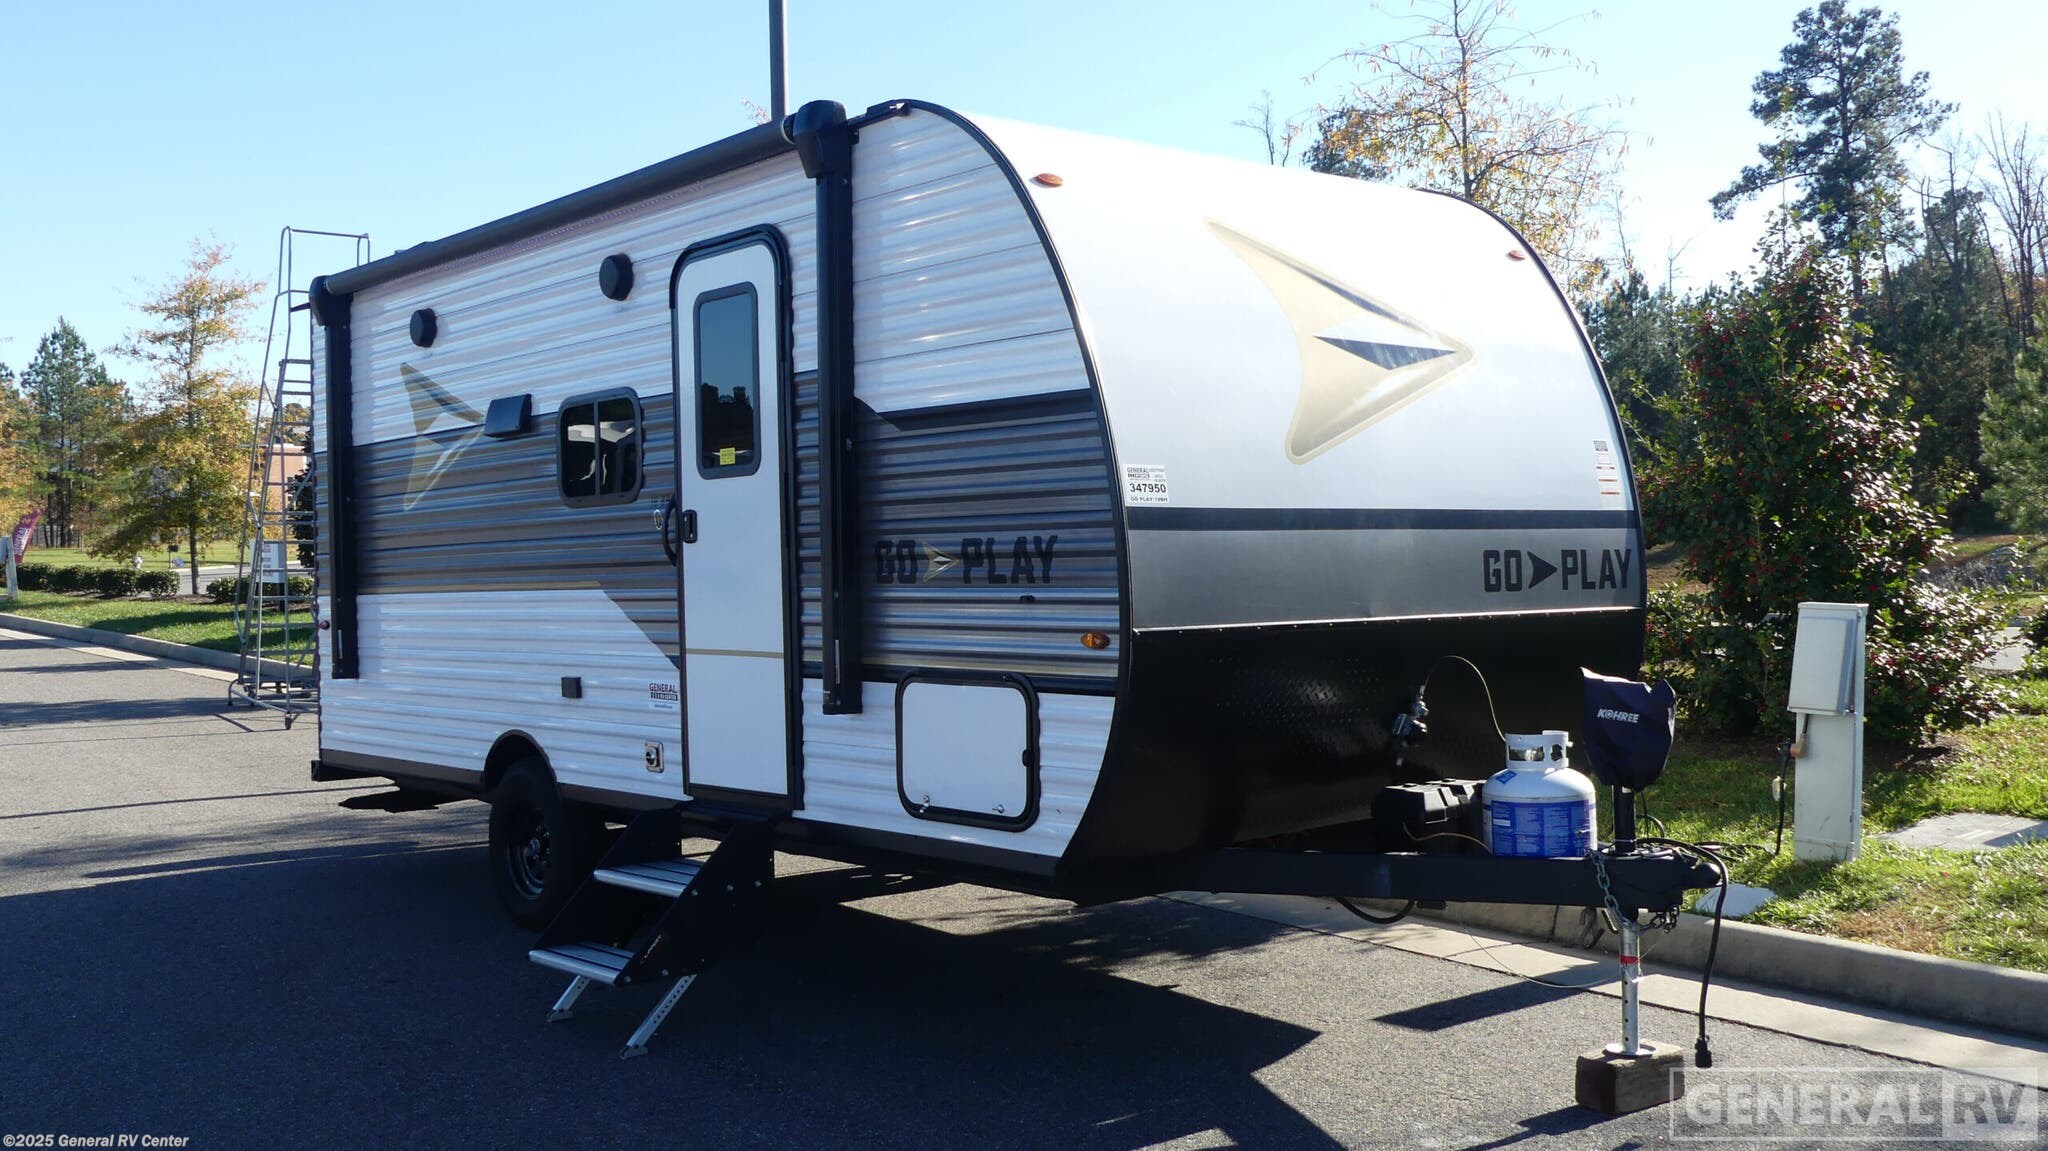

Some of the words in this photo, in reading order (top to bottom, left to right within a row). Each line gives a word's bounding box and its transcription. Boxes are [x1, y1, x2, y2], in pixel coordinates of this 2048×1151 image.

[1130, 483, 1167, 493] 347950
[875, 540, 918, 584] GO
[961, 535, 1058, 584] PLAY
[1483, 549, 1523, 592] GO
[1561, 549, 1632, 590] PLAY
[649, 683, 677, 693] GENERAL
[1597, 708, 1639, 723] KOHREE
